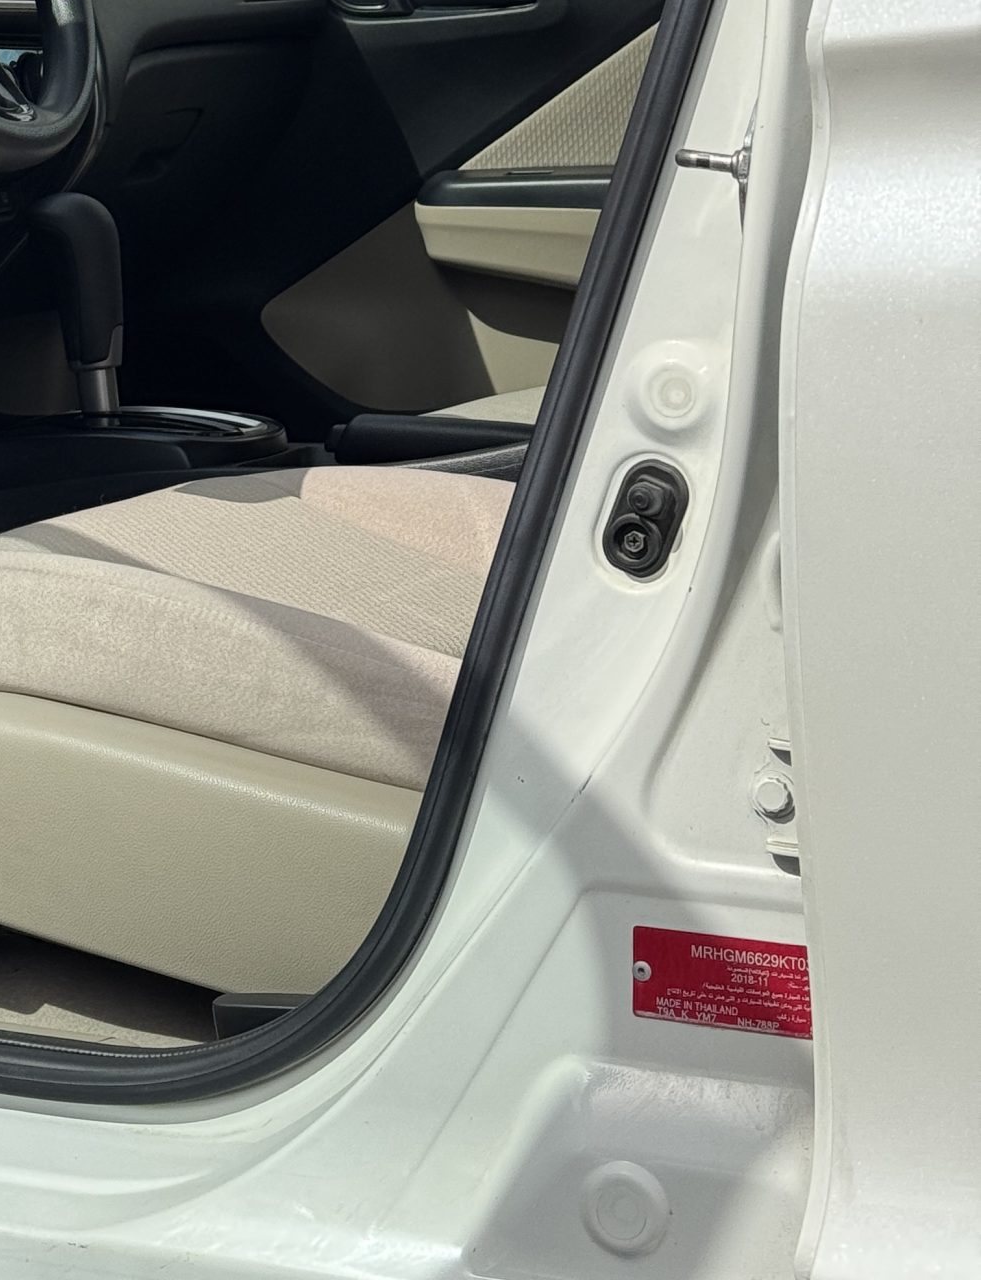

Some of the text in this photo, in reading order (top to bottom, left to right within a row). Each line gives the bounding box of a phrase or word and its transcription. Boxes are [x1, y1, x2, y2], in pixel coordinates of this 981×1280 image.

[731, 973, 768, 987] 2018-11
[656, 996, 738, 1016] MADE IN THAILAND
